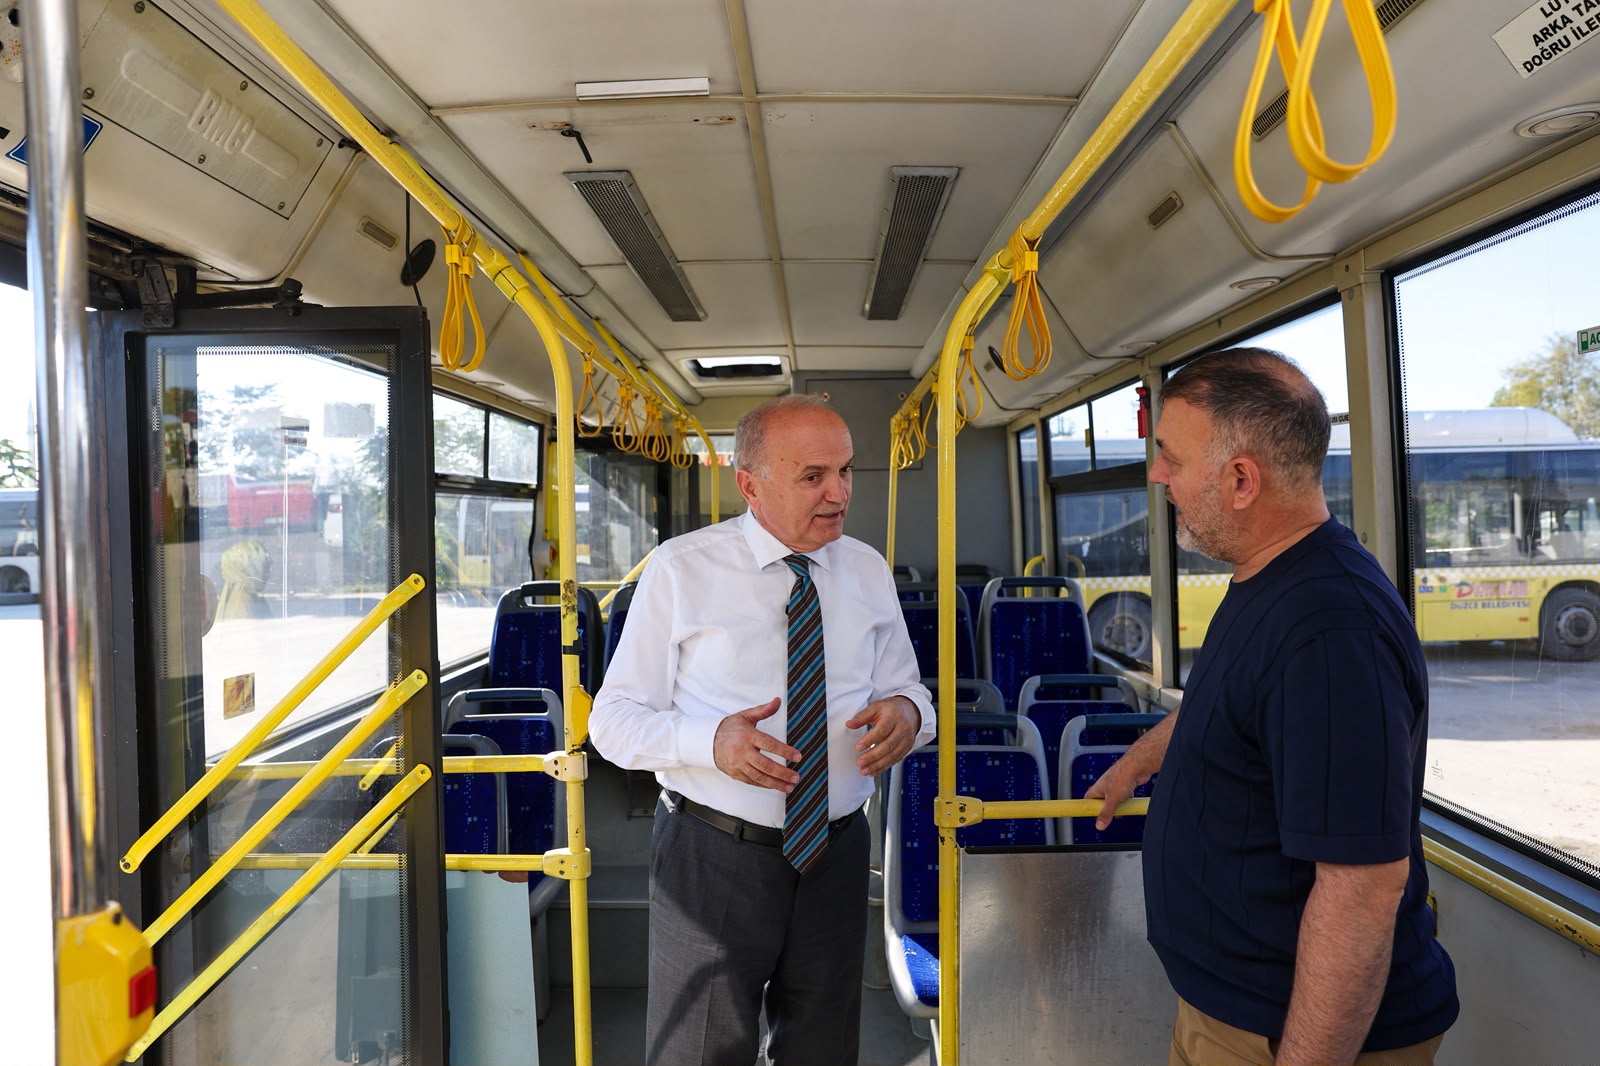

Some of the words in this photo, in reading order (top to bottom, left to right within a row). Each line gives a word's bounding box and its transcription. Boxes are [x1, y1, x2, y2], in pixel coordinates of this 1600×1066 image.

[1532, 14, 1574, 47] ARKA
[1571, 0, 1600, 17] TA
[1540, 0, 1570, 18] LÜ
[1522, 35, 1571, 73] DOĞRU
